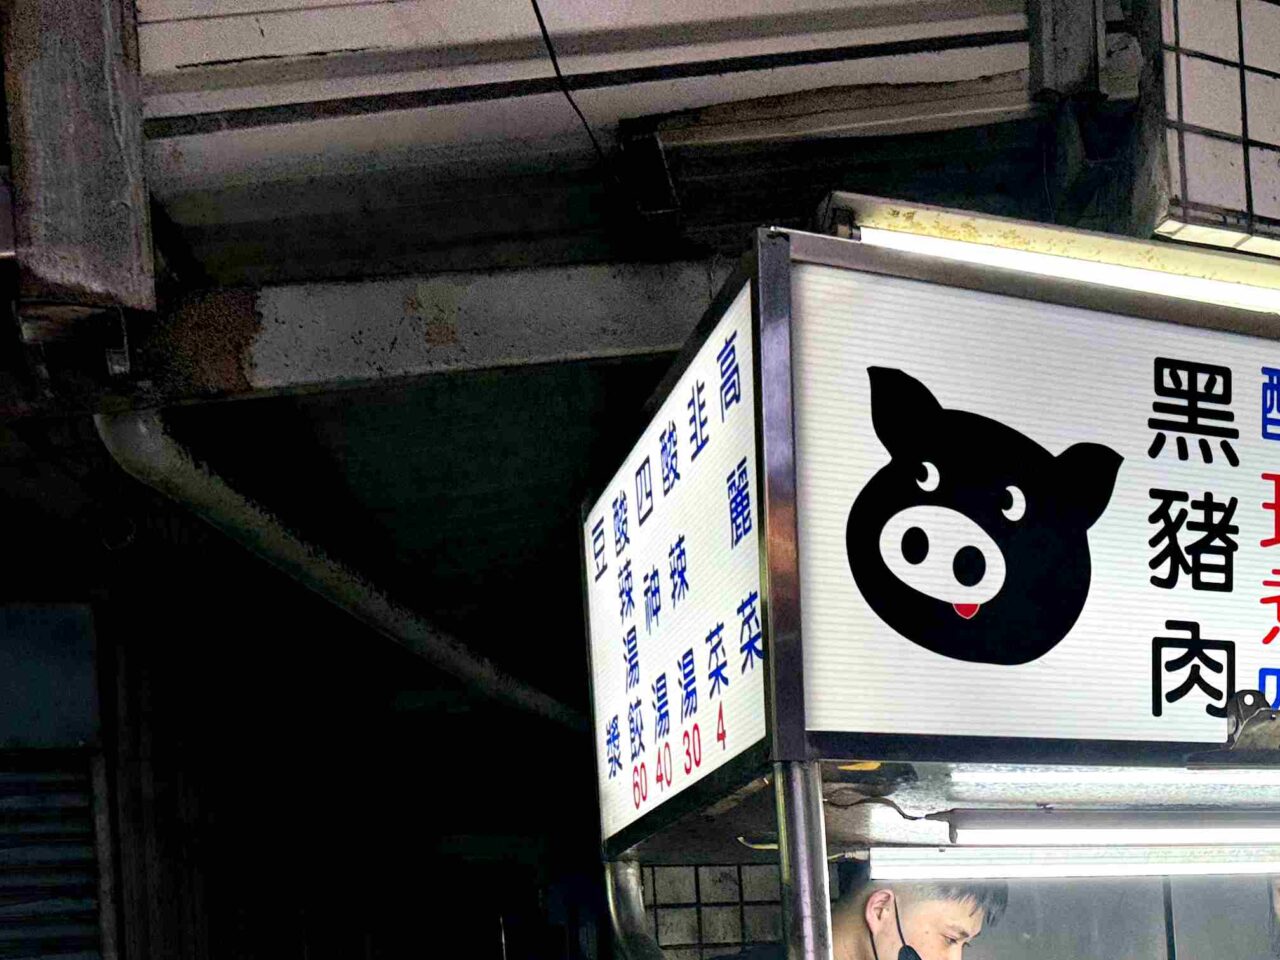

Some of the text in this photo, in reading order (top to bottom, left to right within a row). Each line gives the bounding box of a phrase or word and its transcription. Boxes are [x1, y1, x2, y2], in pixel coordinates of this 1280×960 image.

[591, 515, 623, 780] 豆漿
[612, 489, 648, 810] 酸辣湯餃 60
[635, 454, 673, 792] 四神湯 40
[658, 420, 702, 775] 酸辣湯 30
[688, 378, 729, 750] 韭菜 4
[715, 330, 764, 675] 高麗菜
[1147, 356, 1240, 718] 黑豬肉
